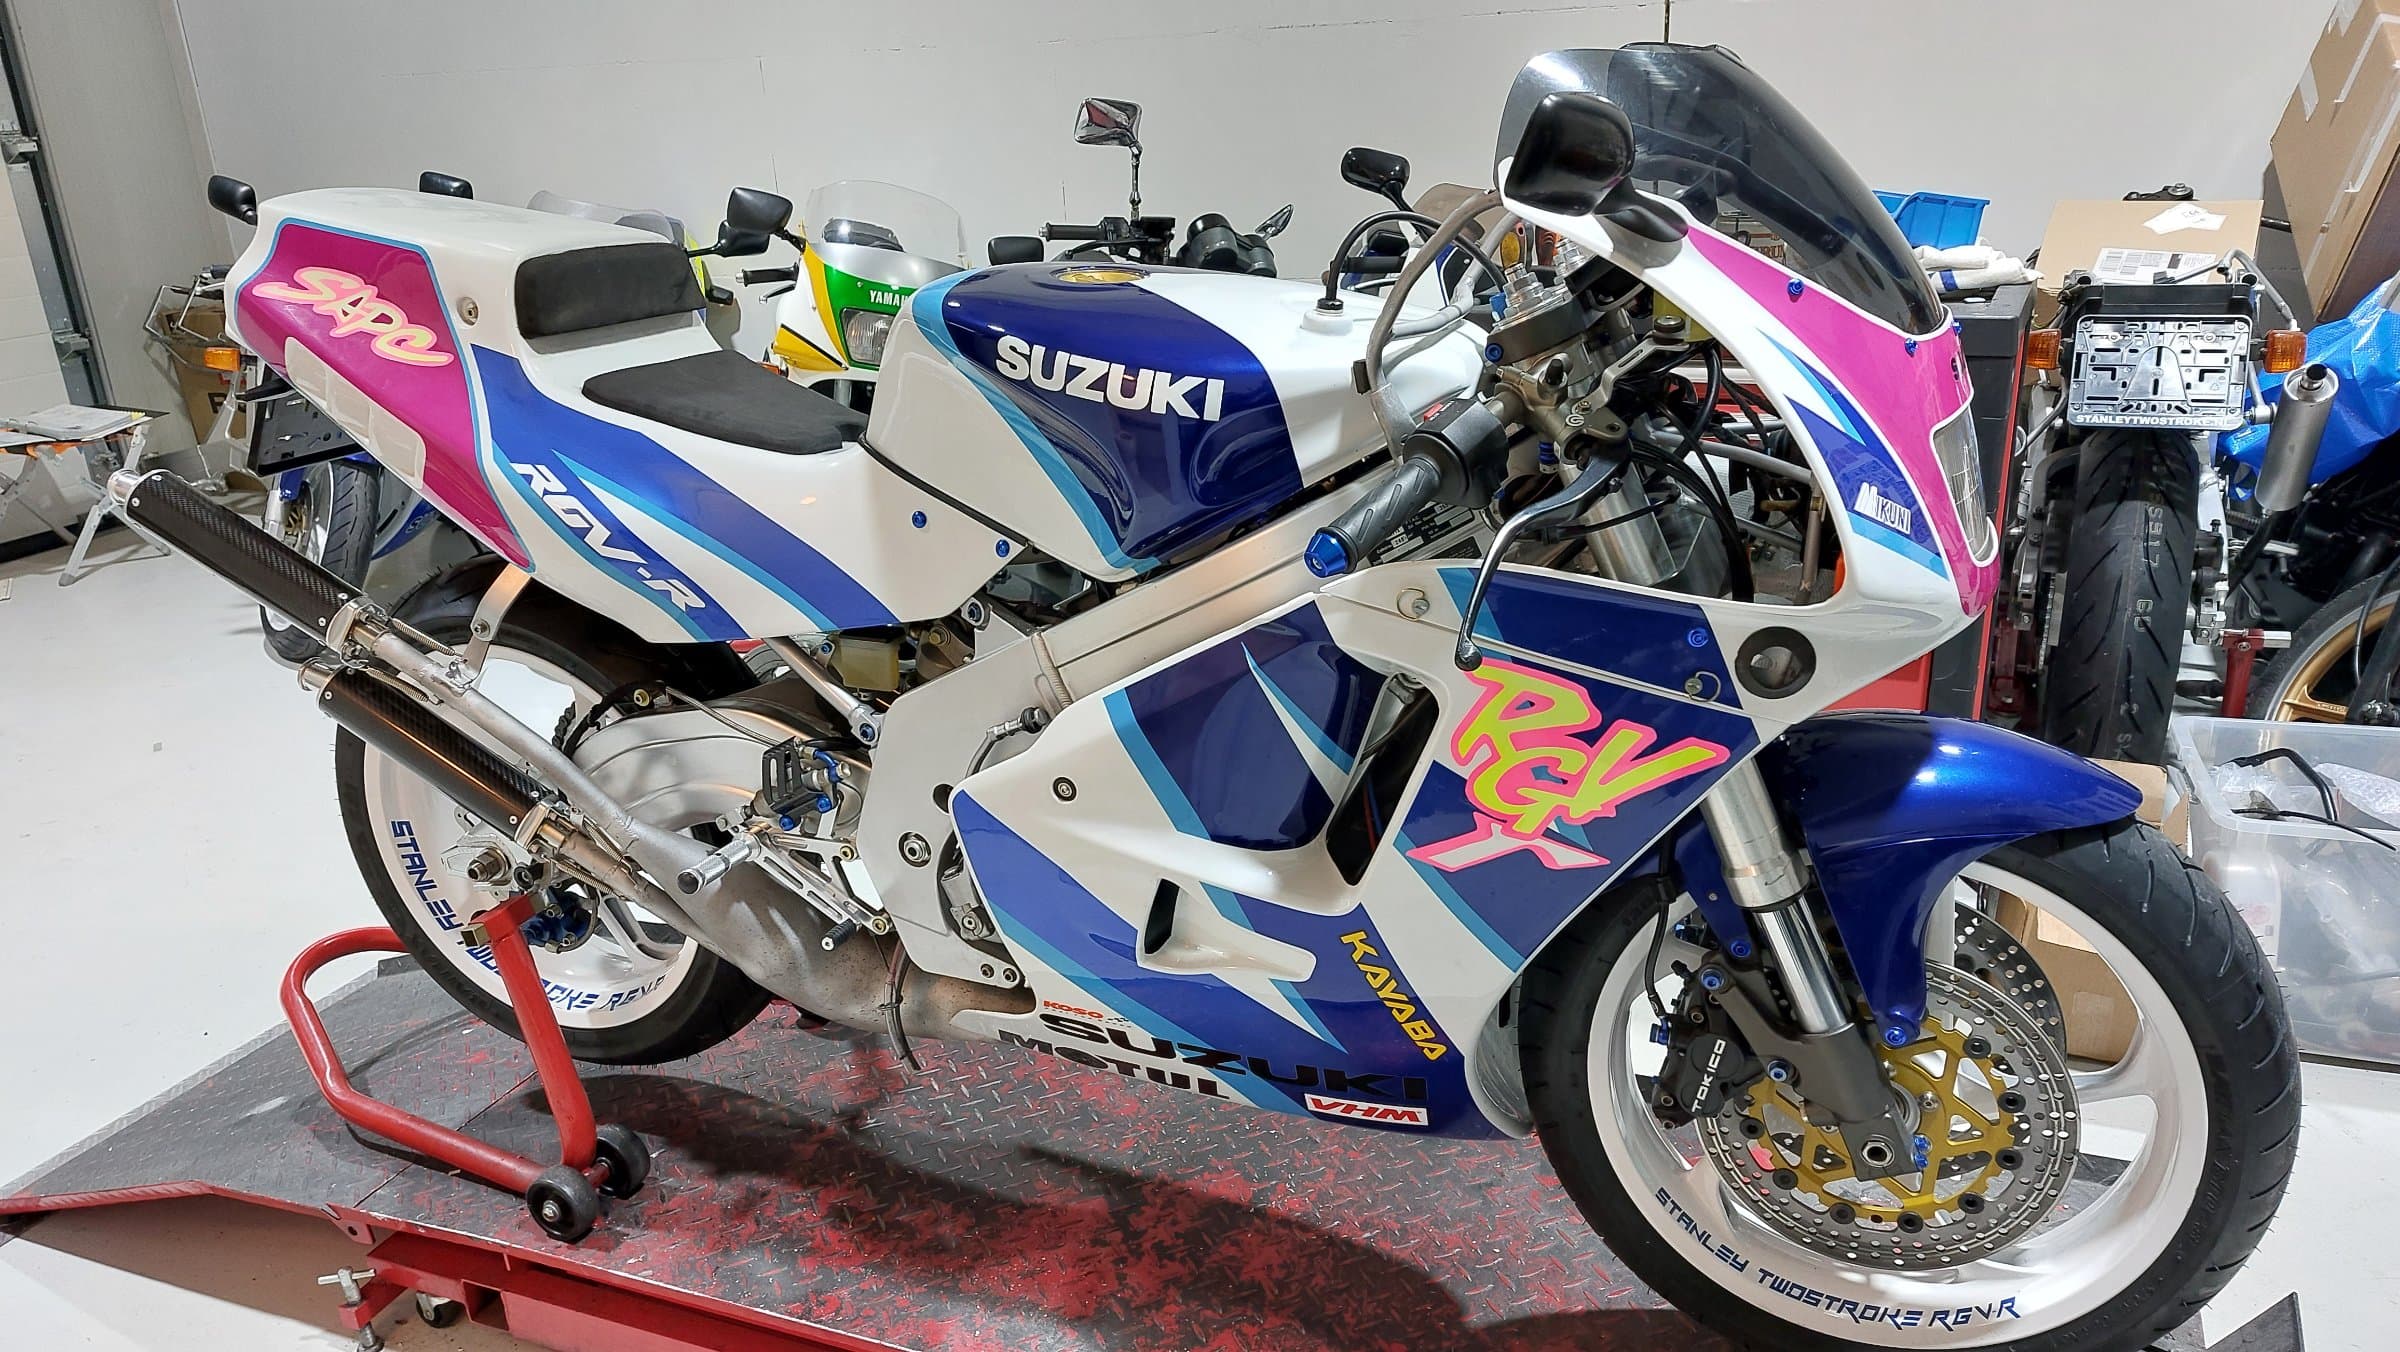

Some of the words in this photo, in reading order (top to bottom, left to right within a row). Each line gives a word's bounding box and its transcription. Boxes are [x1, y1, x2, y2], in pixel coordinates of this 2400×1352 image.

[252, 266, 455, 367] SAPC
[996, 334, 1225, 422] SUZUKI
[509, 462, 706, 612] RGV-R
[1451, 656, 1731, 838] RGV
[391, 819, 464, 931] STANLEY
[1043, 1000, 1104, 1019] KOSO
[1339, 930, 1448, 1061] KAYABA
[998, 1029, 1230, 1099] MOTUL
[1039, 1013, 1429, 1100] SUZUKI
[1691, 1039, 1727, 1113] TOKICO
[1310, 1098, 1421, 1122] VHM
[1655, 1187, 1751, 1274] STANLEY
[1757, 1267, 1925, 1331] TWOSTROKE
[1927, 1296, 2021, 1332] RGV-R
